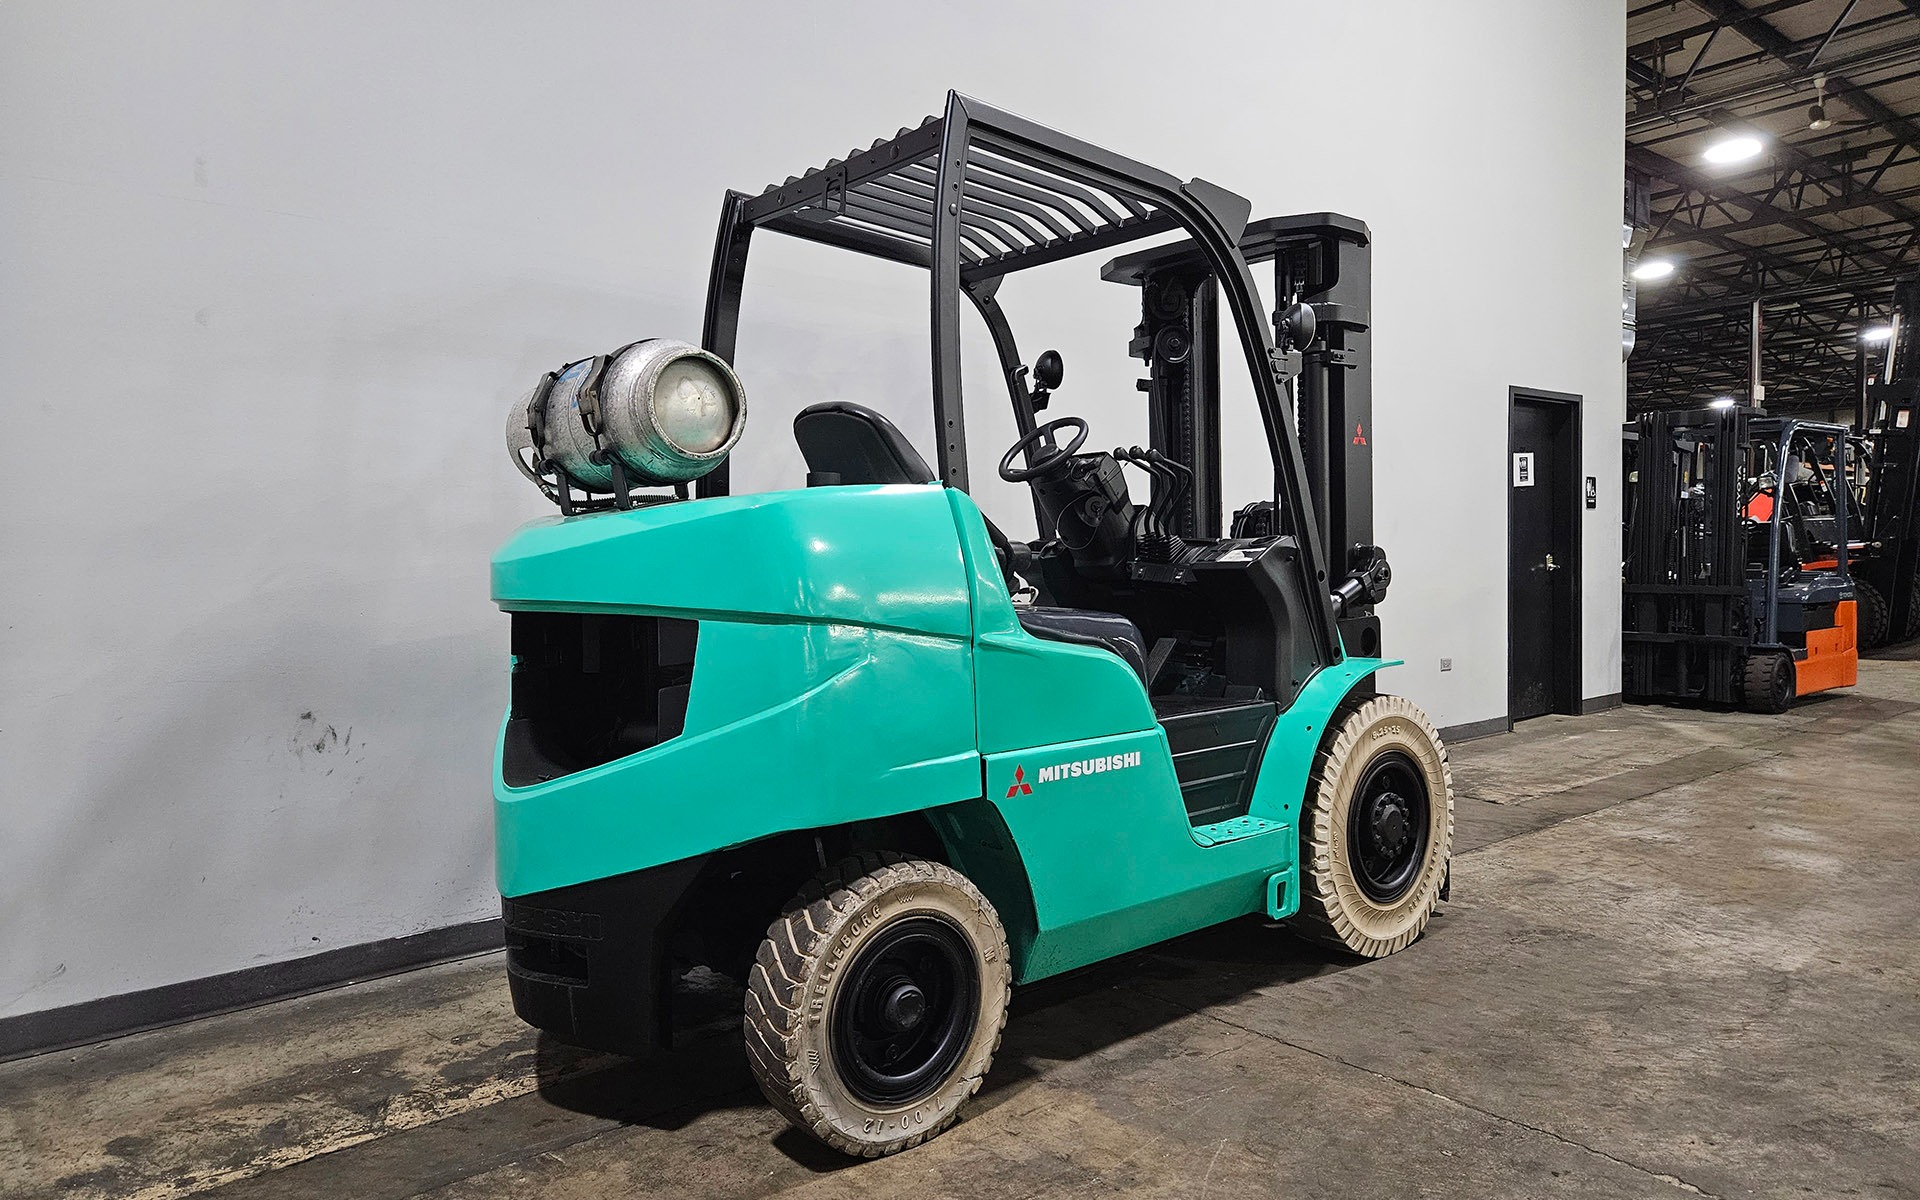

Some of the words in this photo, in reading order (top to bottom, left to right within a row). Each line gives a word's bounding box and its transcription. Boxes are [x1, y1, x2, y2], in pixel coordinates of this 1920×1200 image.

[1038, 751, 1141, 784] MITSUBISHI
[808, 903, 882, 1024] TRELLEBORG
[862, 1095, 946, 1135] 7.00-12
